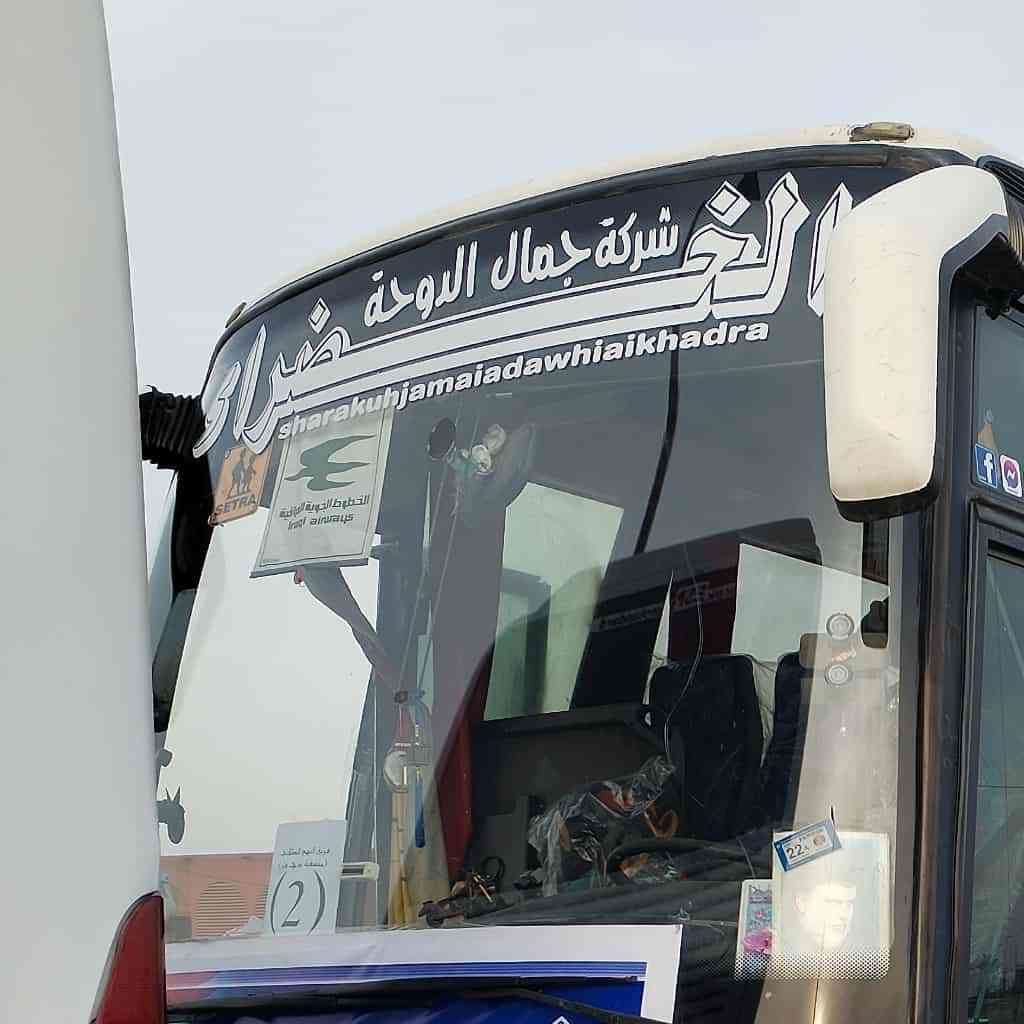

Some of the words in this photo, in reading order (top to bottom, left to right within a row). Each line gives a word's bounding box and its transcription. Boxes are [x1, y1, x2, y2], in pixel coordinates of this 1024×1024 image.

[490, 226, 592, 290] جمال
[594, 206, 680, 273] شركة
[363, 240, 479, 328] الدوحة
[215, 493, 257, 513] SETRA
